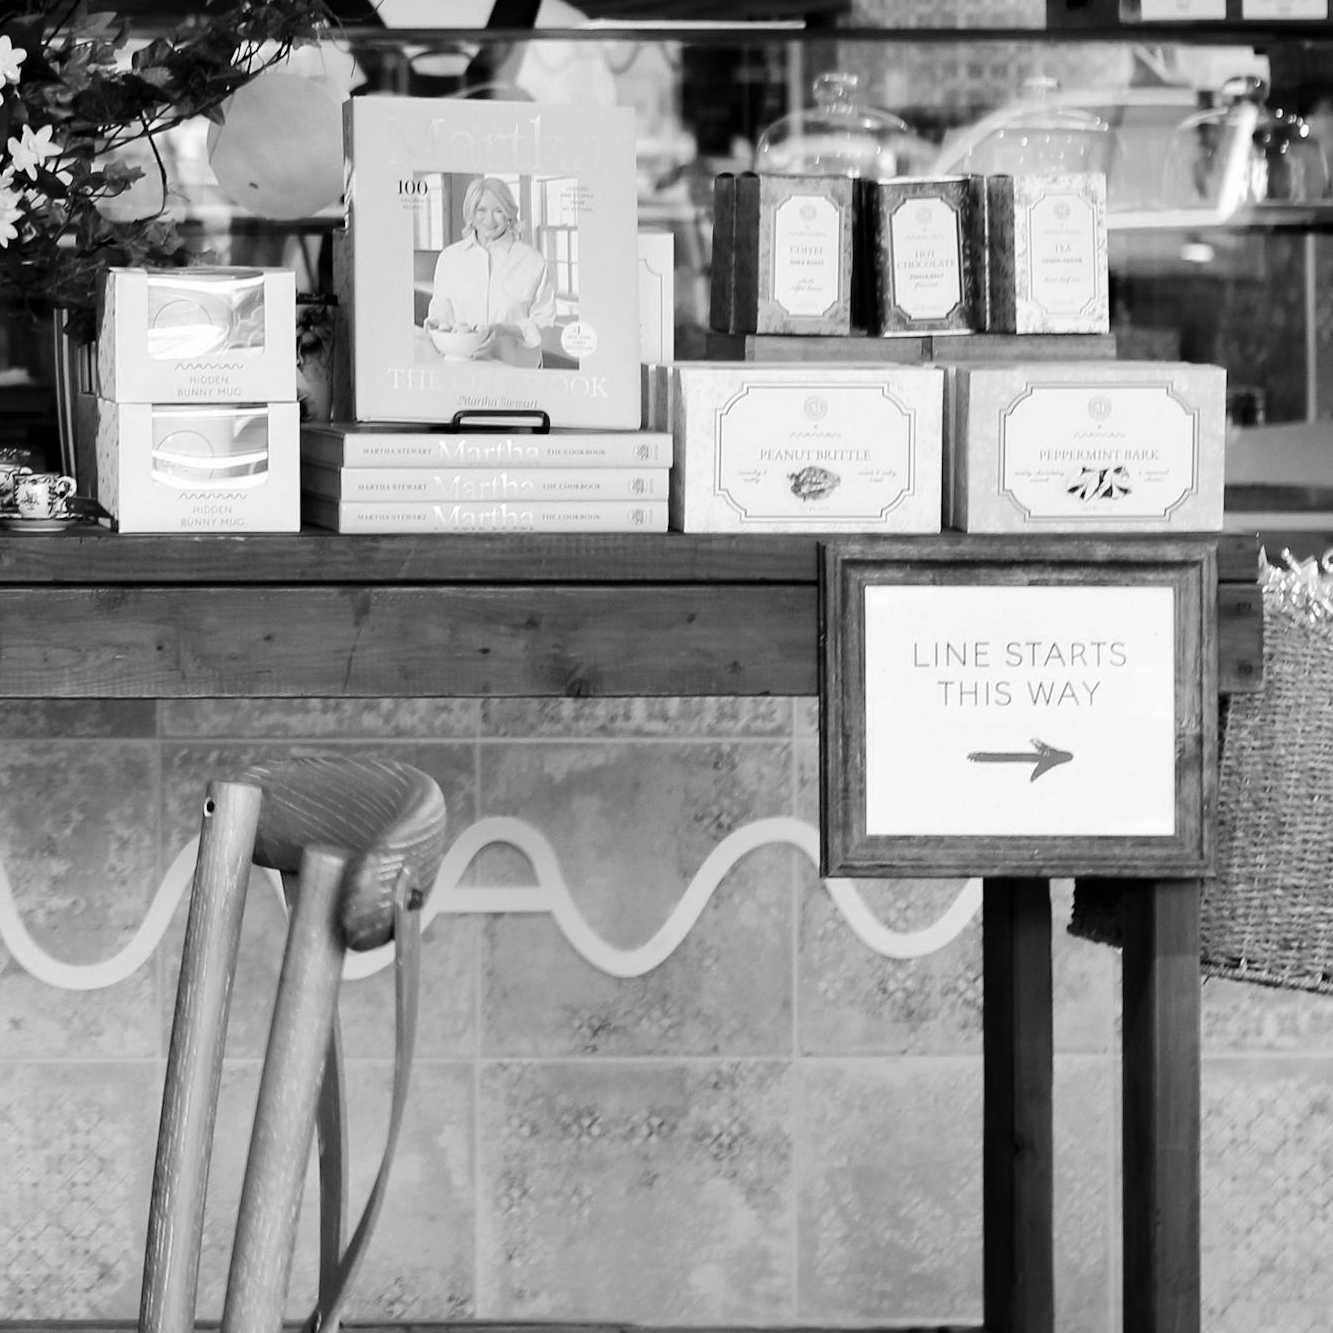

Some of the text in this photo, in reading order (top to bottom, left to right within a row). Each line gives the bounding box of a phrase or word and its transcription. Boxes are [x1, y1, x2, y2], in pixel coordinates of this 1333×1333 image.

[397, 179, 429, 196] 100
[789, 246, 824, 255] COFFEE
[1055, 243, 1072, 252] TEA
[914, 251, 935, 259] HOT
[190, 375, 229, 385] HIDDEN
[178, 387, 242, 397] BUNNY MUG
[457, 395, 539, 409] Martha Stewart
[362, 438, 607, 464] MARTHA STEWART Martha THE COOKBOOK
[759, 449, 871, 461] PEANUT BRITTLE
[1038, 449, 1160, 461] PEPPERMINT BARK
[358, 472, 602, 500] MARTHA STEWART Martha THE COOKBOOK
[192, 505, 233, 515] HIDDEN
[357, 502, 601, 530] MARTHA STEWART Martha THE COOKBOOK
[181, 518, 245, 527] BUNNY MUG
[913, 641, 1128, 668] LINE STARTS
[937, 680, 1102, 707] THIS WAY
